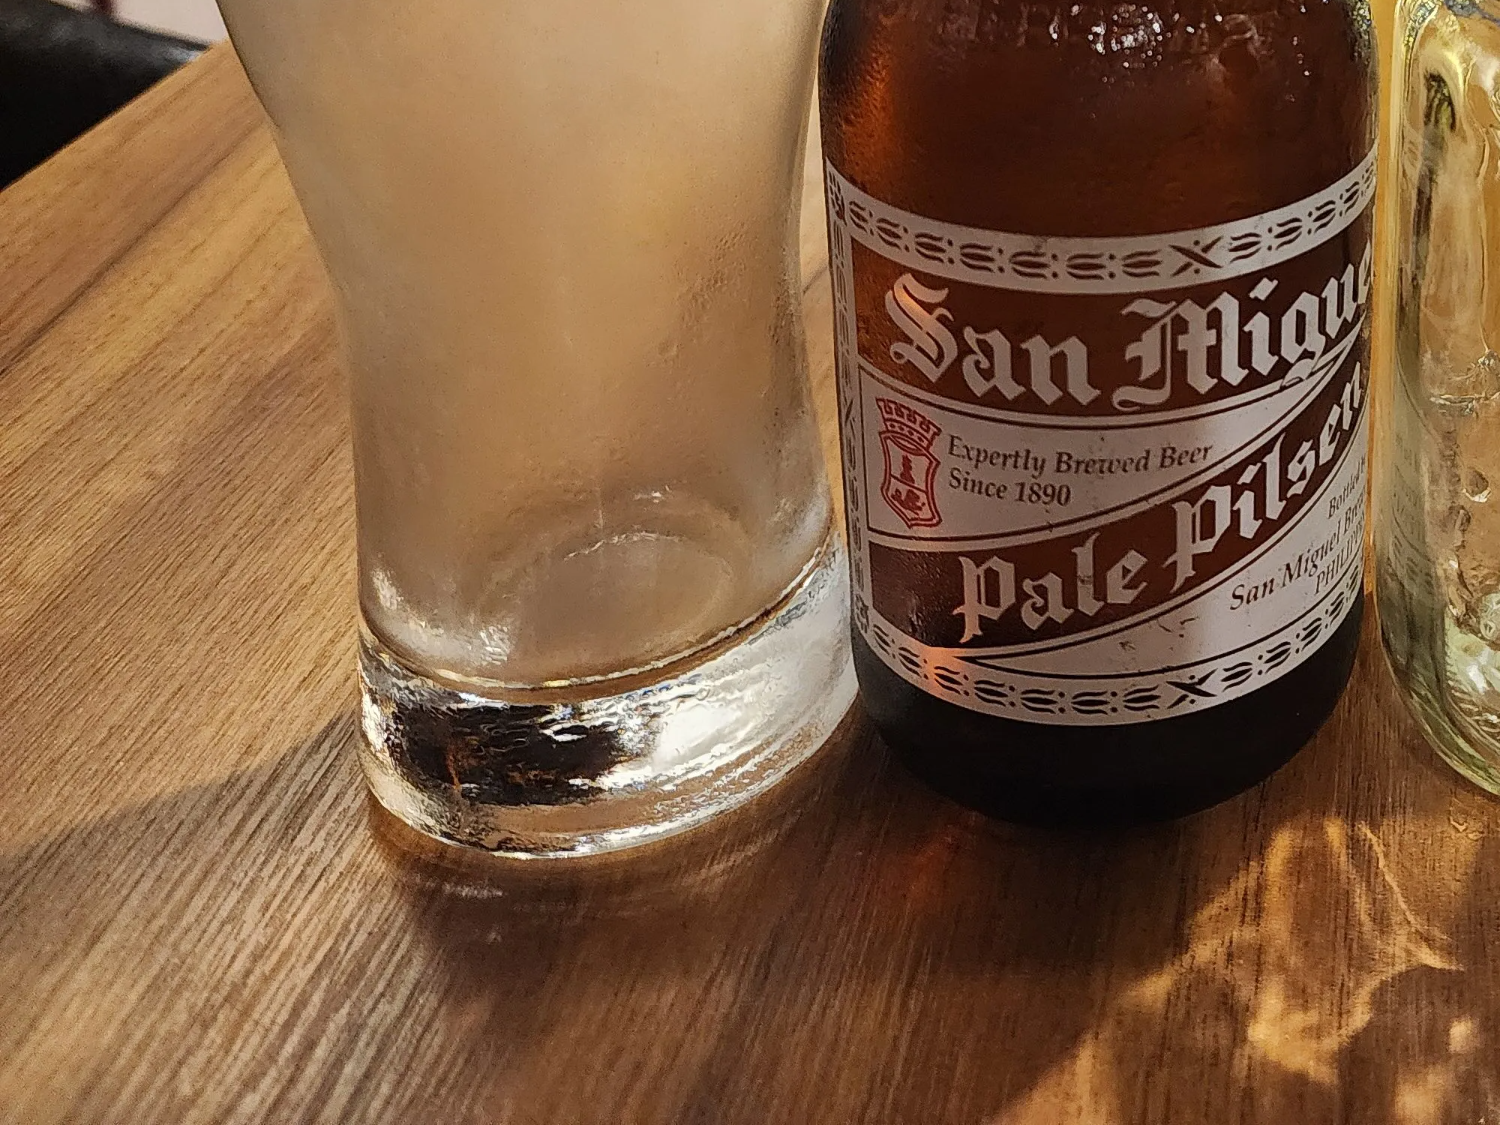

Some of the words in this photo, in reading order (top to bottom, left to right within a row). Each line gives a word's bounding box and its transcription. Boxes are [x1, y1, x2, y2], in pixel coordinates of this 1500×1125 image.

[885, 273, 1101, 406] San
[948, 434, 1046, 480] Expertly
[1055, 448, 1150, 475] Brewed
[1160, 444, 1213, 469] Beer
[949, 468, 1007, 500] Since
[1014, 481, 1071, 507] 1890
[953, 534, 1149, 644] Pale
[1164, 361, 1362, 594] Pilsen
[1230, 577, 1275, 611] San
[1281, 519, 1341, 589] Miguel
